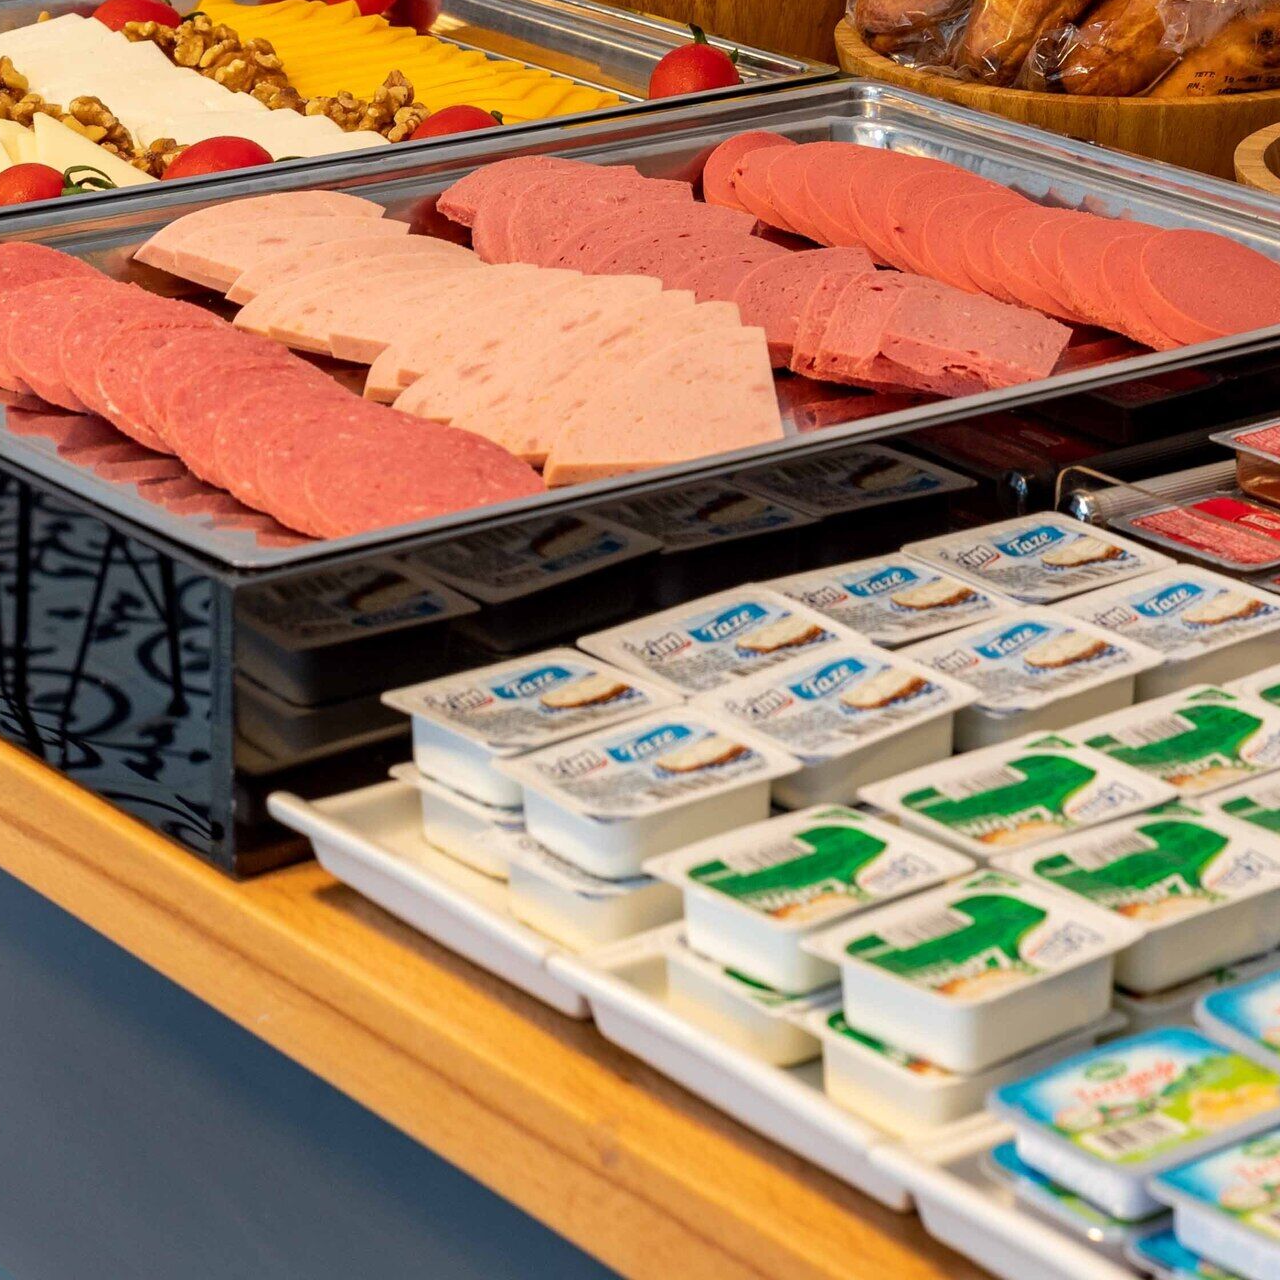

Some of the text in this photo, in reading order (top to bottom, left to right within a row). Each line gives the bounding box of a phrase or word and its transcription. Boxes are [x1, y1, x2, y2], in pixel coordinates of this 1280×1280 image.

[1008, 531, 1053, 556] Taze
[857, 570, 906, 596] Taze
[1146, 587, 1192, 614] Taze
[703, 608, 751, 638] Taze
[987, 626, 1036, 660] Taze
[505, 671, 555, 698] Taze
[802, 664, 851, 695] Taze
[625, 725, 677, 760] Taze
